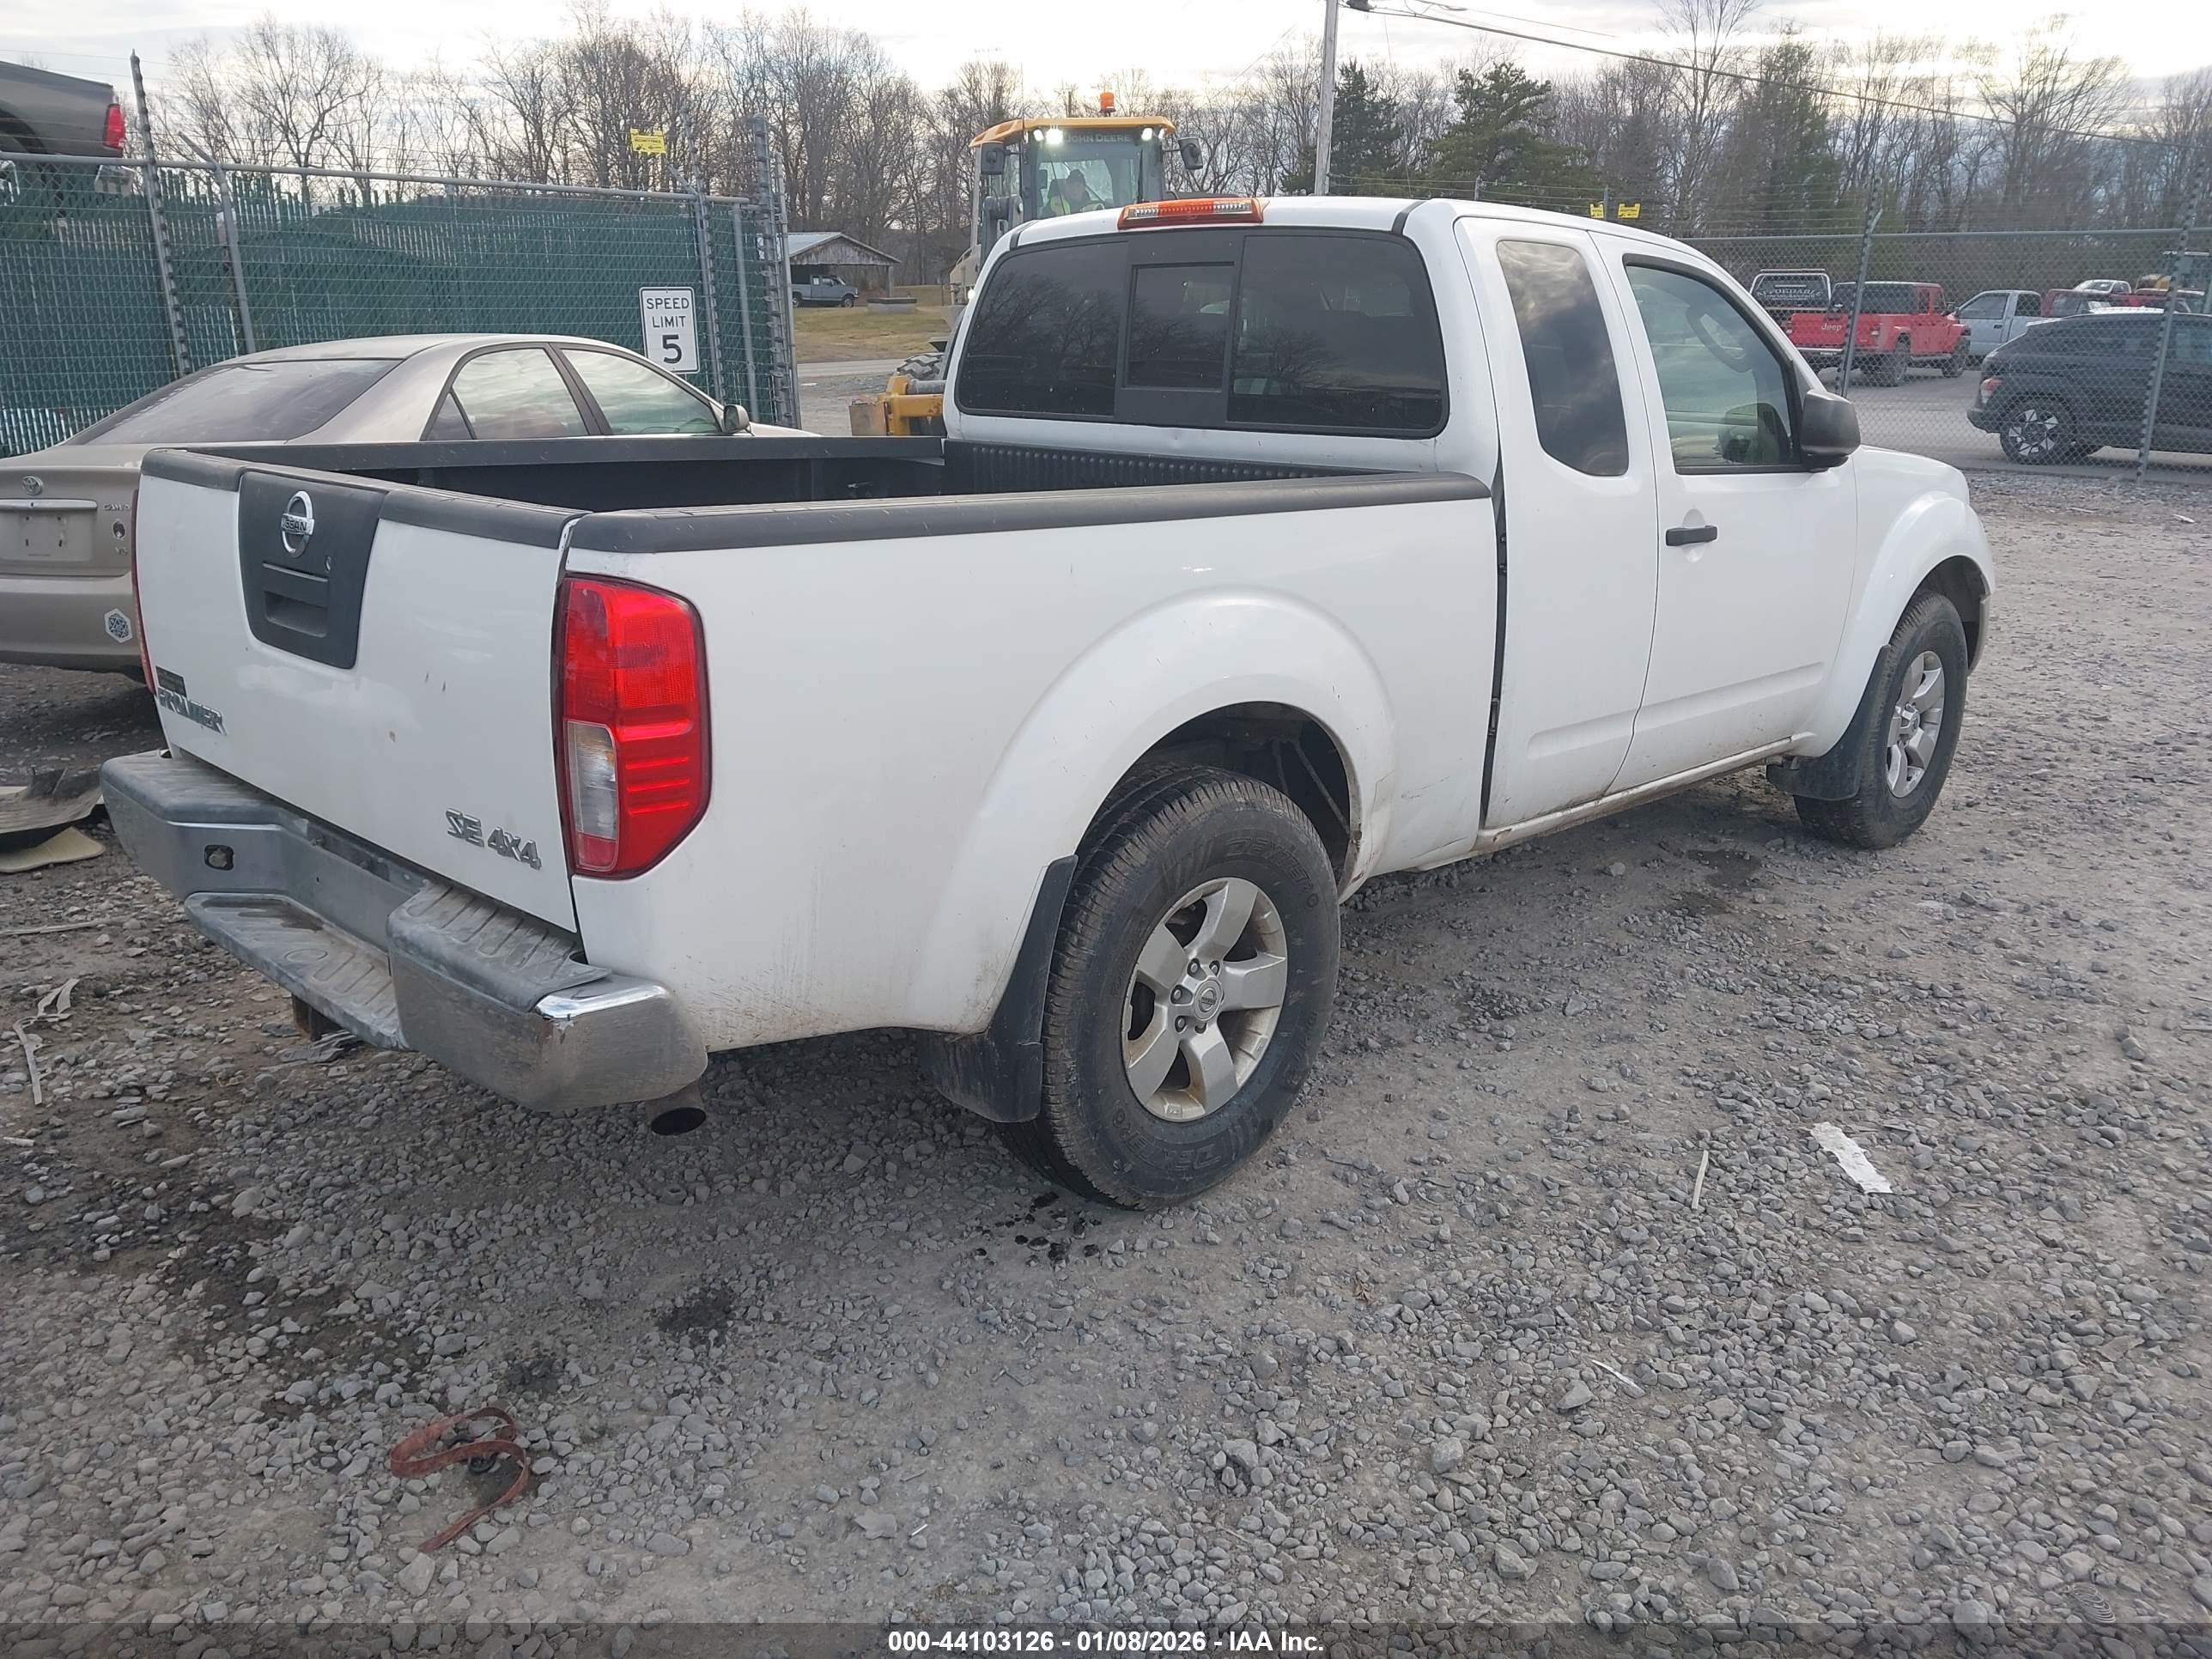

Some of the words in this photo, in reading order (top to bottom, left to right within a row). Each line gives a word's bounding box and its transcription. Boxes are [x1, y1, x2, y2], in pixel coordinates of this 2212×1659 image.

[1096, 134, 1131, 143] DEERE
[646, 297, 690, 310] SPEED
[653, 316, 686, 328] LIMIT
[1821, 323, 1843, 331] Jeep
[662, 334, 683, 364] 5
[445, 808, 485, 848] SE
